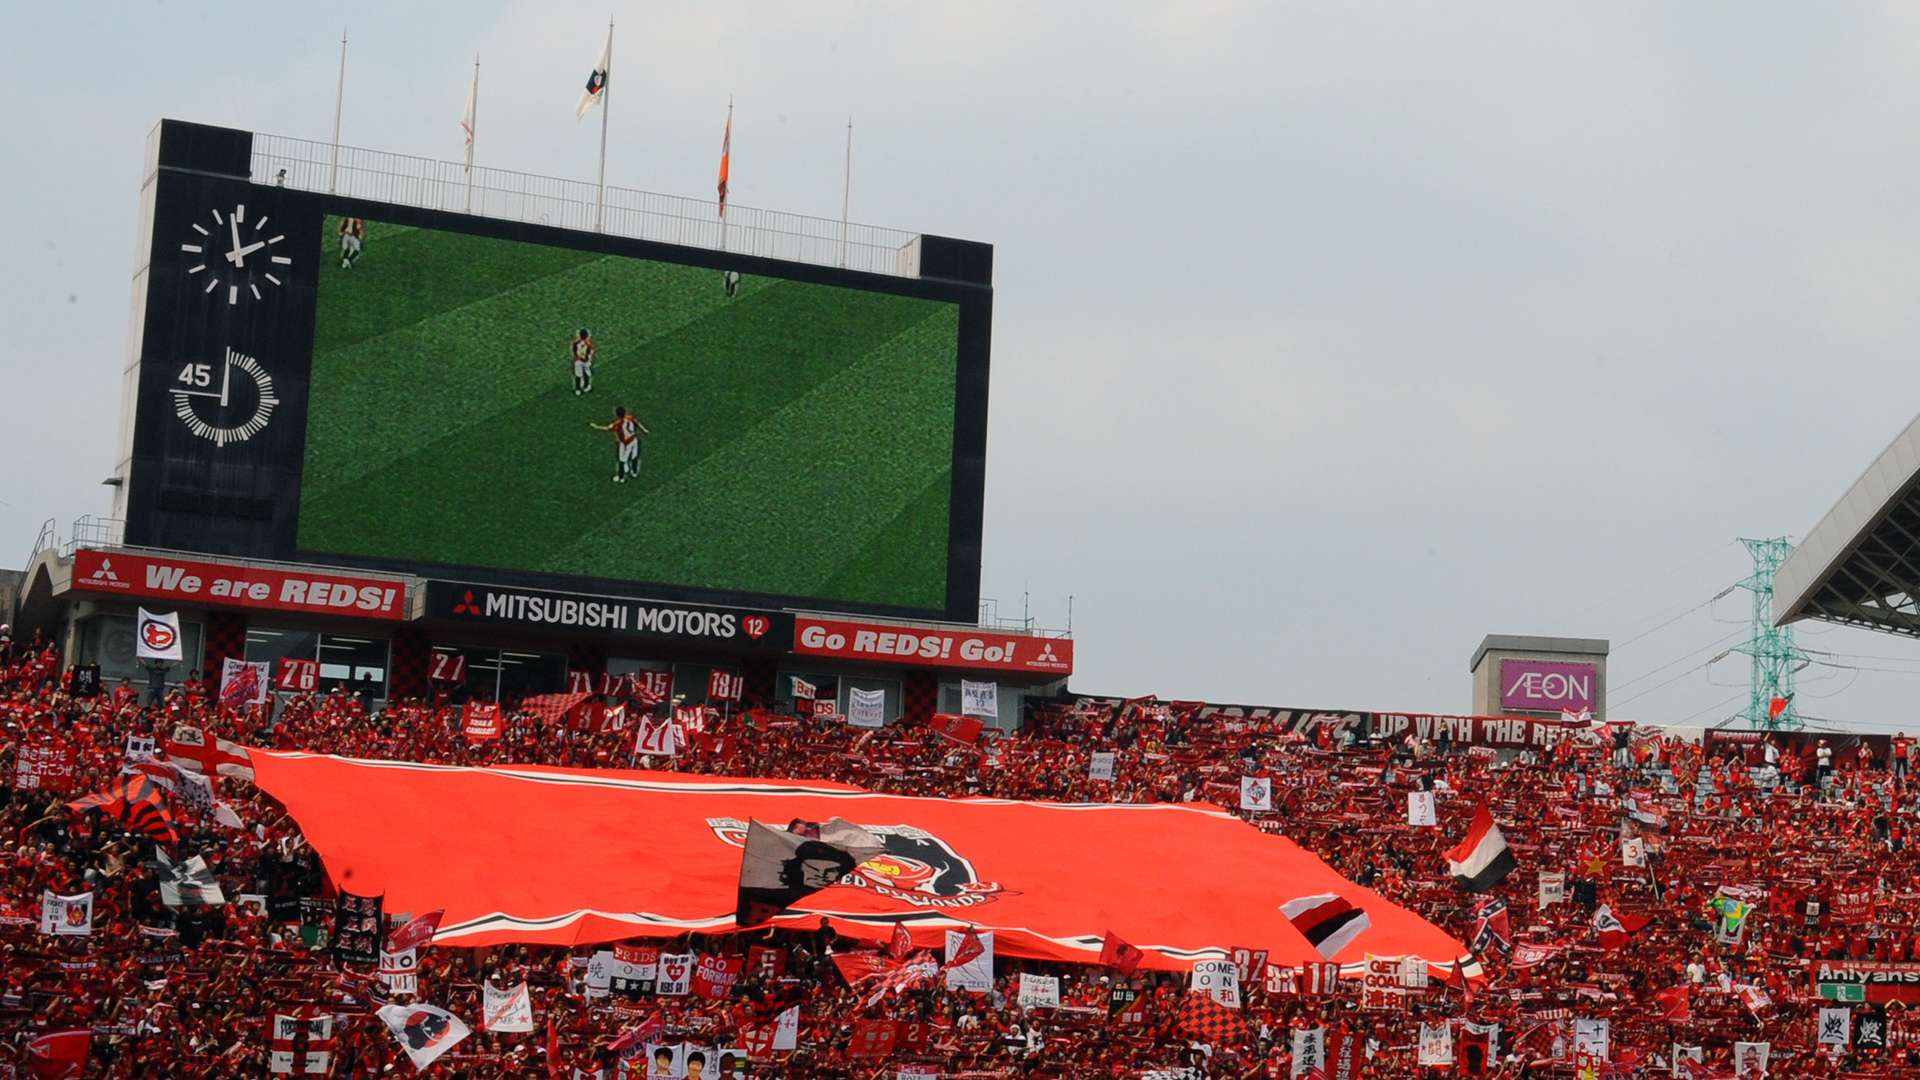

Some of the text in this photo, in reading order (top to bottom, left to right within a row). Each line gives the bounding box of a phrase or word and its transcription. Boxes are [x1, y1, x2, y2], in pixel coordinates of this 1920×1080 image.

[178, 363, 211, 387] 45
[146, 564, 396, 611] We are REDS!
[485, 592, 736, 638] MITSUBISHI MOTORS
[748, 619, 763, 635] 12
[801, 626, 1016, 662] Go REDS! Go!
[281, 661, 316, 690] 26
[1379, 714, 1409, 738] UP
[1415, 717, 1473, 742] WITH
[1482, 719, 1527, 744] THE
[704, 956, 727, 971] GO
[1195, 962, 1235, 976] COME
[1235, 949, 1267, 981] 32
[1369, 960, 1402, 974] GET
[1309, 963, 1339, 995] 10
